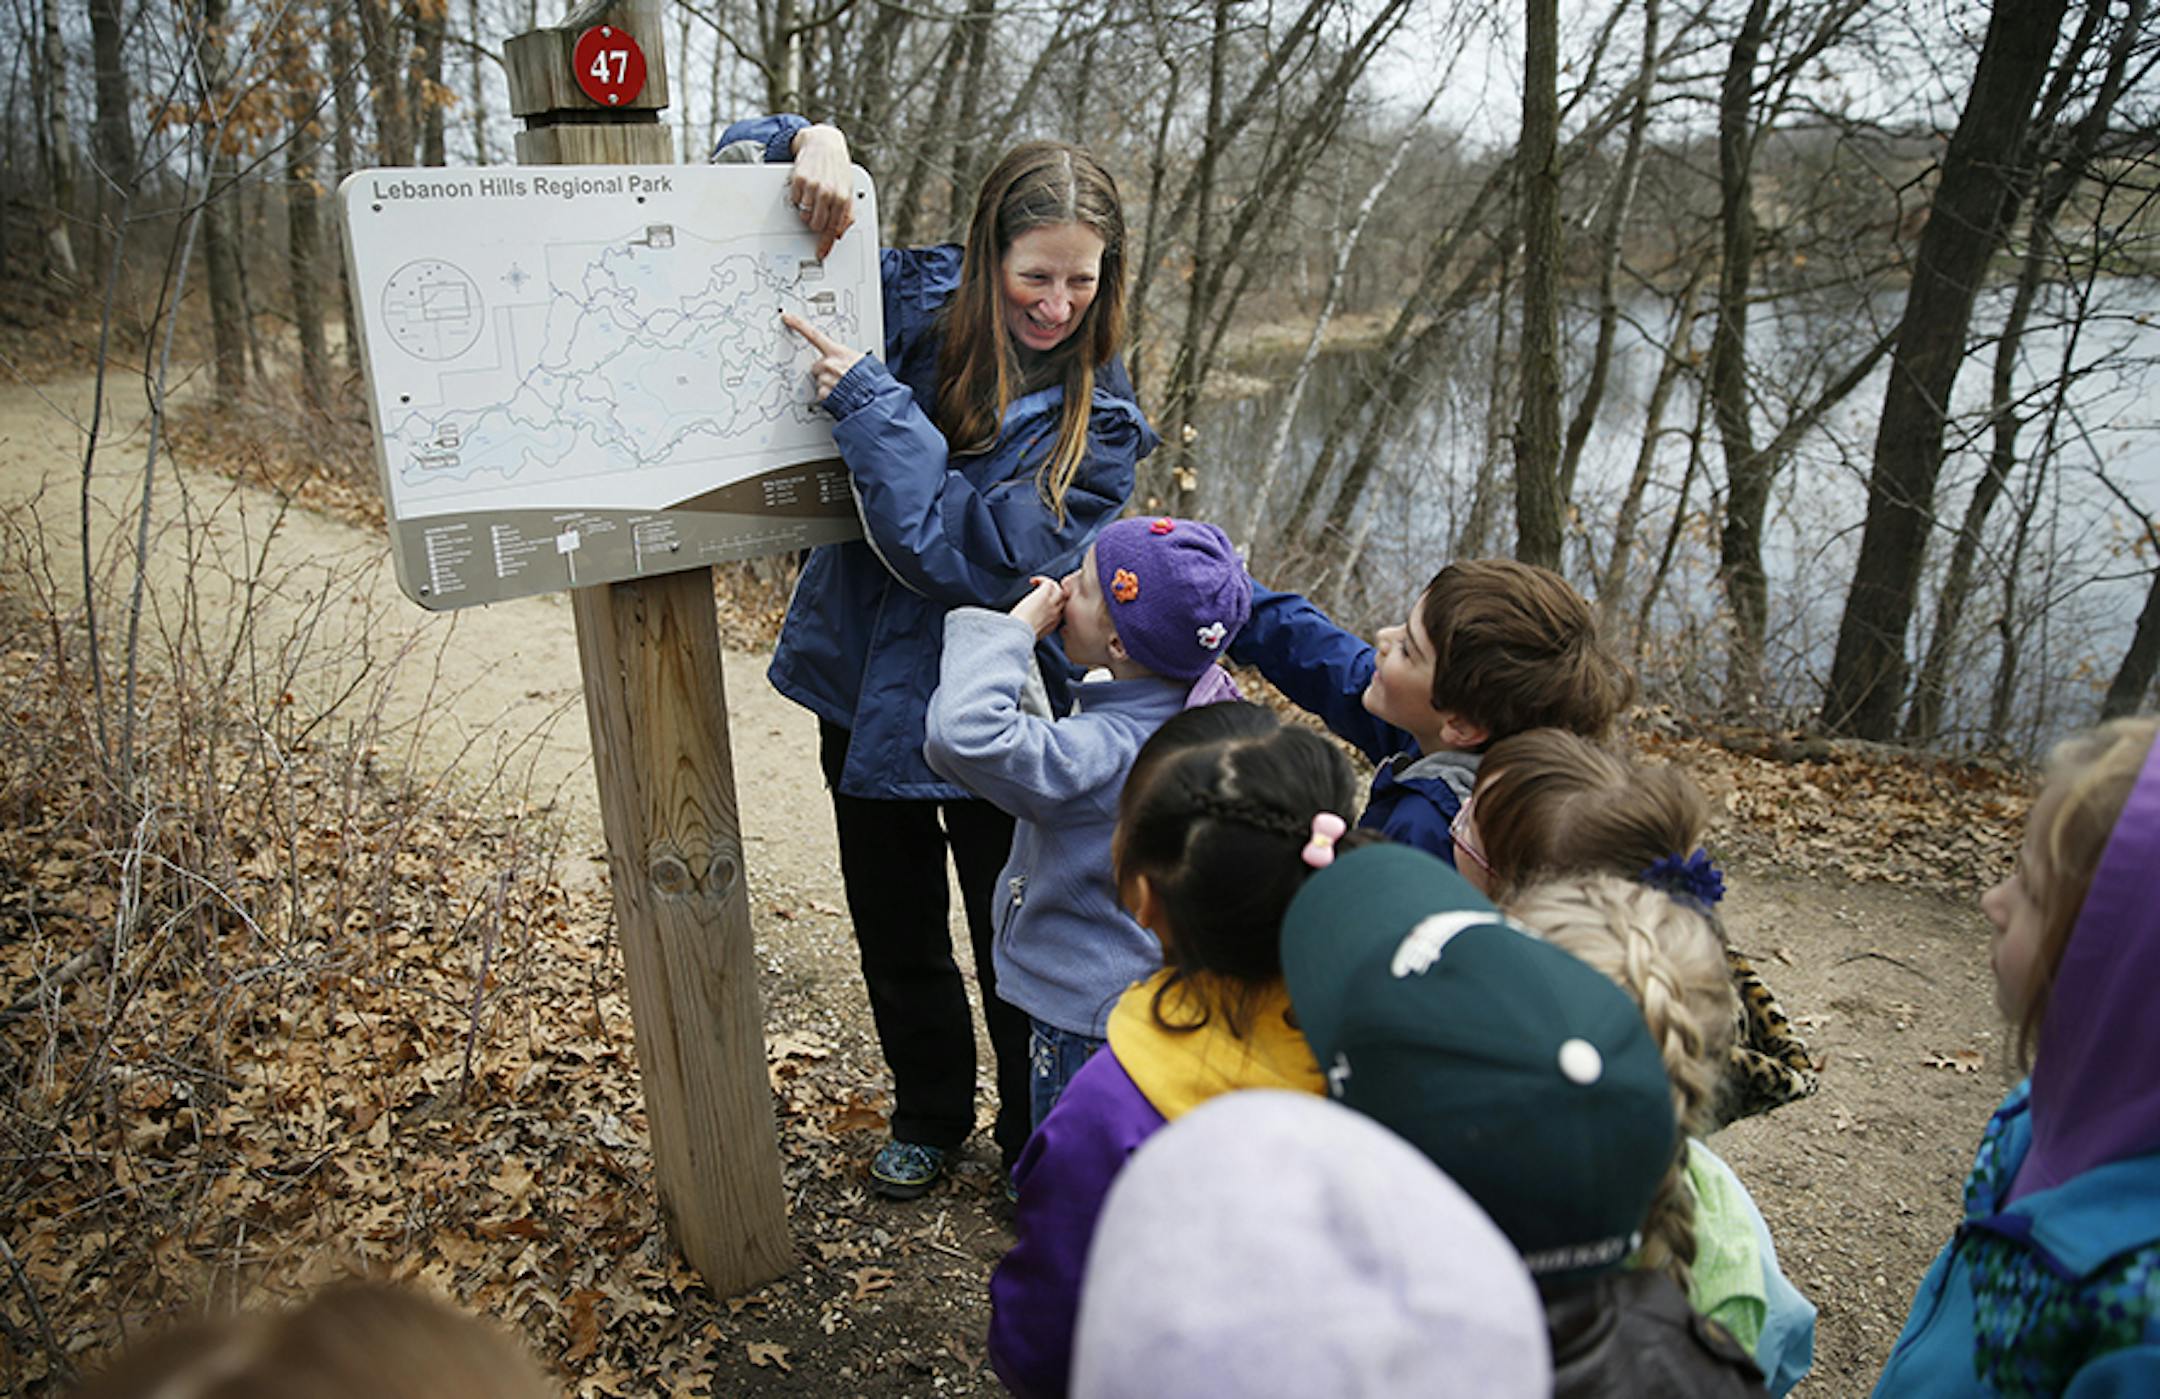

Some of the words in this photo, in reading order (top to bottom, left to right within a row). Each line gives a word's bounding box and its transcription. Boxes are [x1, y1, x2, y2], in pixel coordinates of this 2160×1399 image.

[590, 49, 629, 84] 47
[373, 181, 473, 199] Lebanon
[479, 178, 527, 197] Hills
[533, 176, 622, 199] Regional
[629, 175, 673, 192] Park
